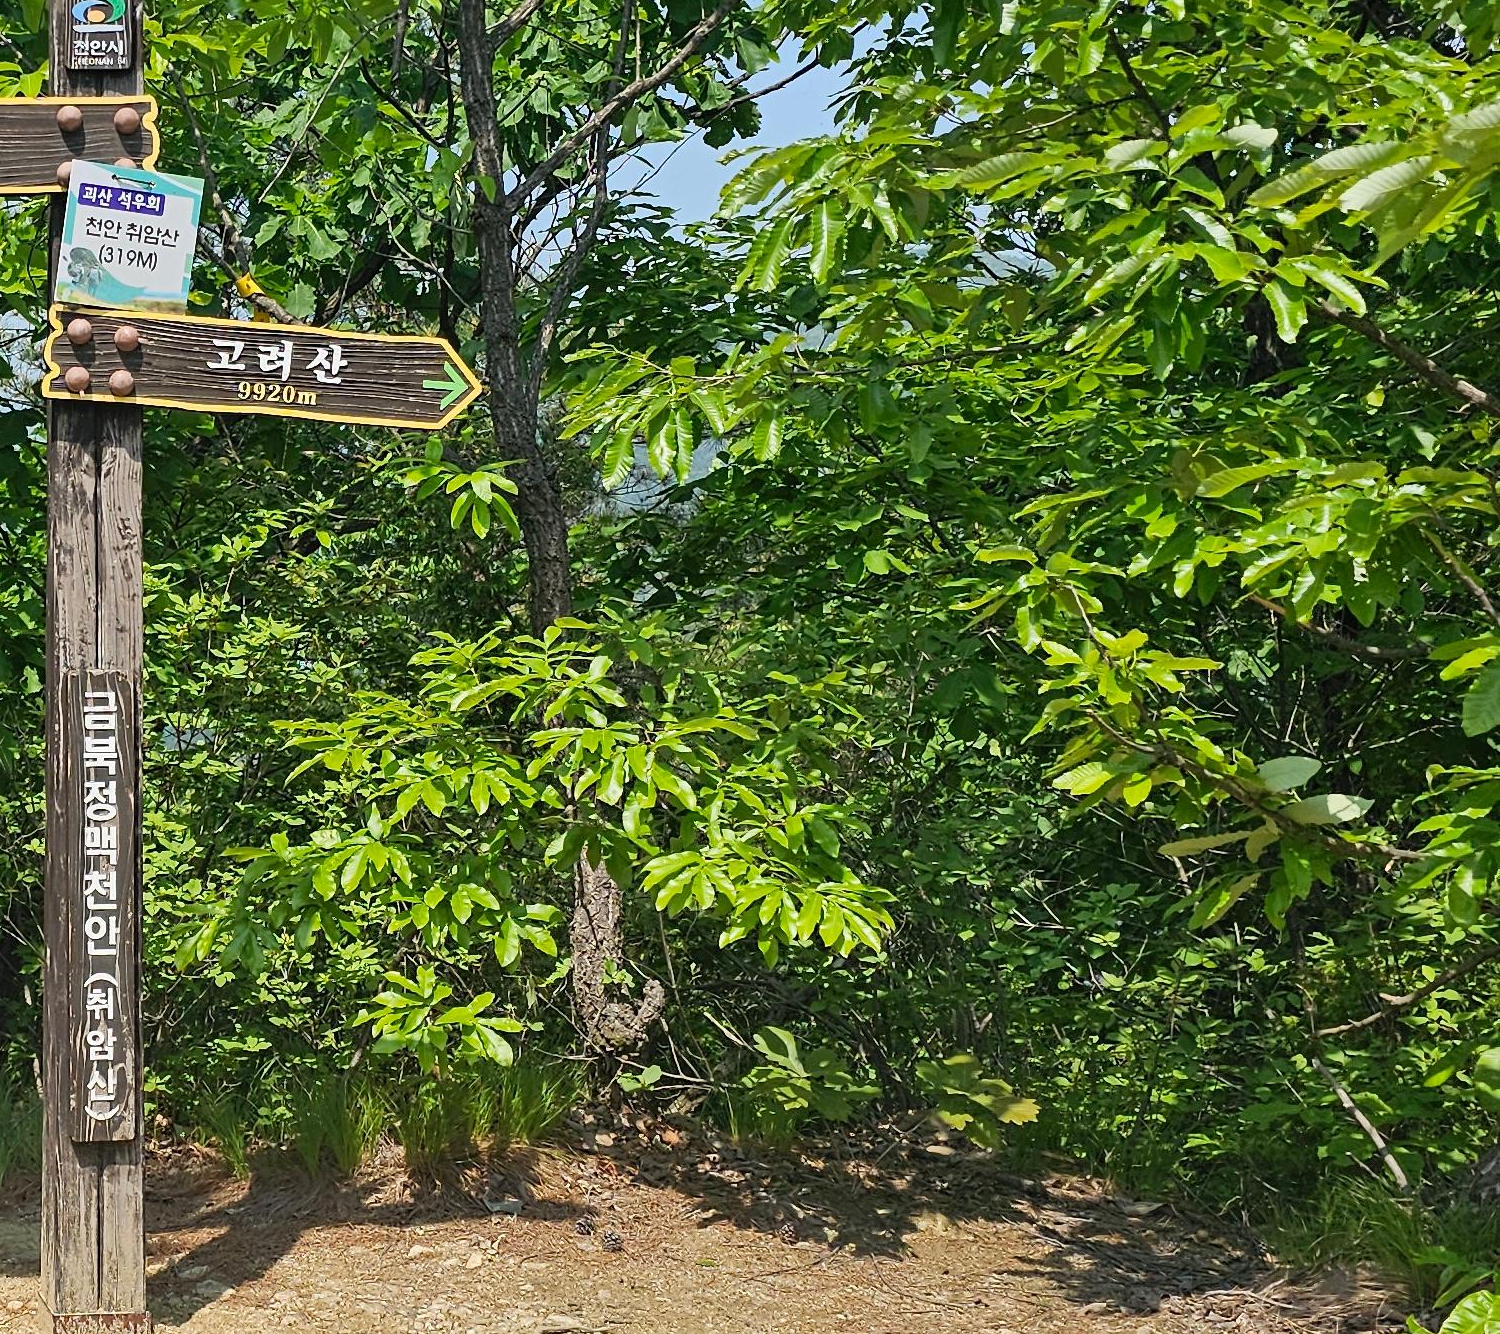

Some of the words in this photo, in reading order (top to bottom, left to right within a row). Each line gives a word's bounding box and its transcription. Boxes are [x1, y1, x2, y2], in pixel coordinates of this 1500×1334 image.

[82, 186, 113, 207] 괴산
[117, 191, 161, 212] 석우회
[85, 216, 122, 240] 천안
[125, 222, 180, 248] 취암산
[98, 244, 158, 272] (319M)
[206, 339, 348, 385] 고려산
[237, 381, 318, 406] 9920m
